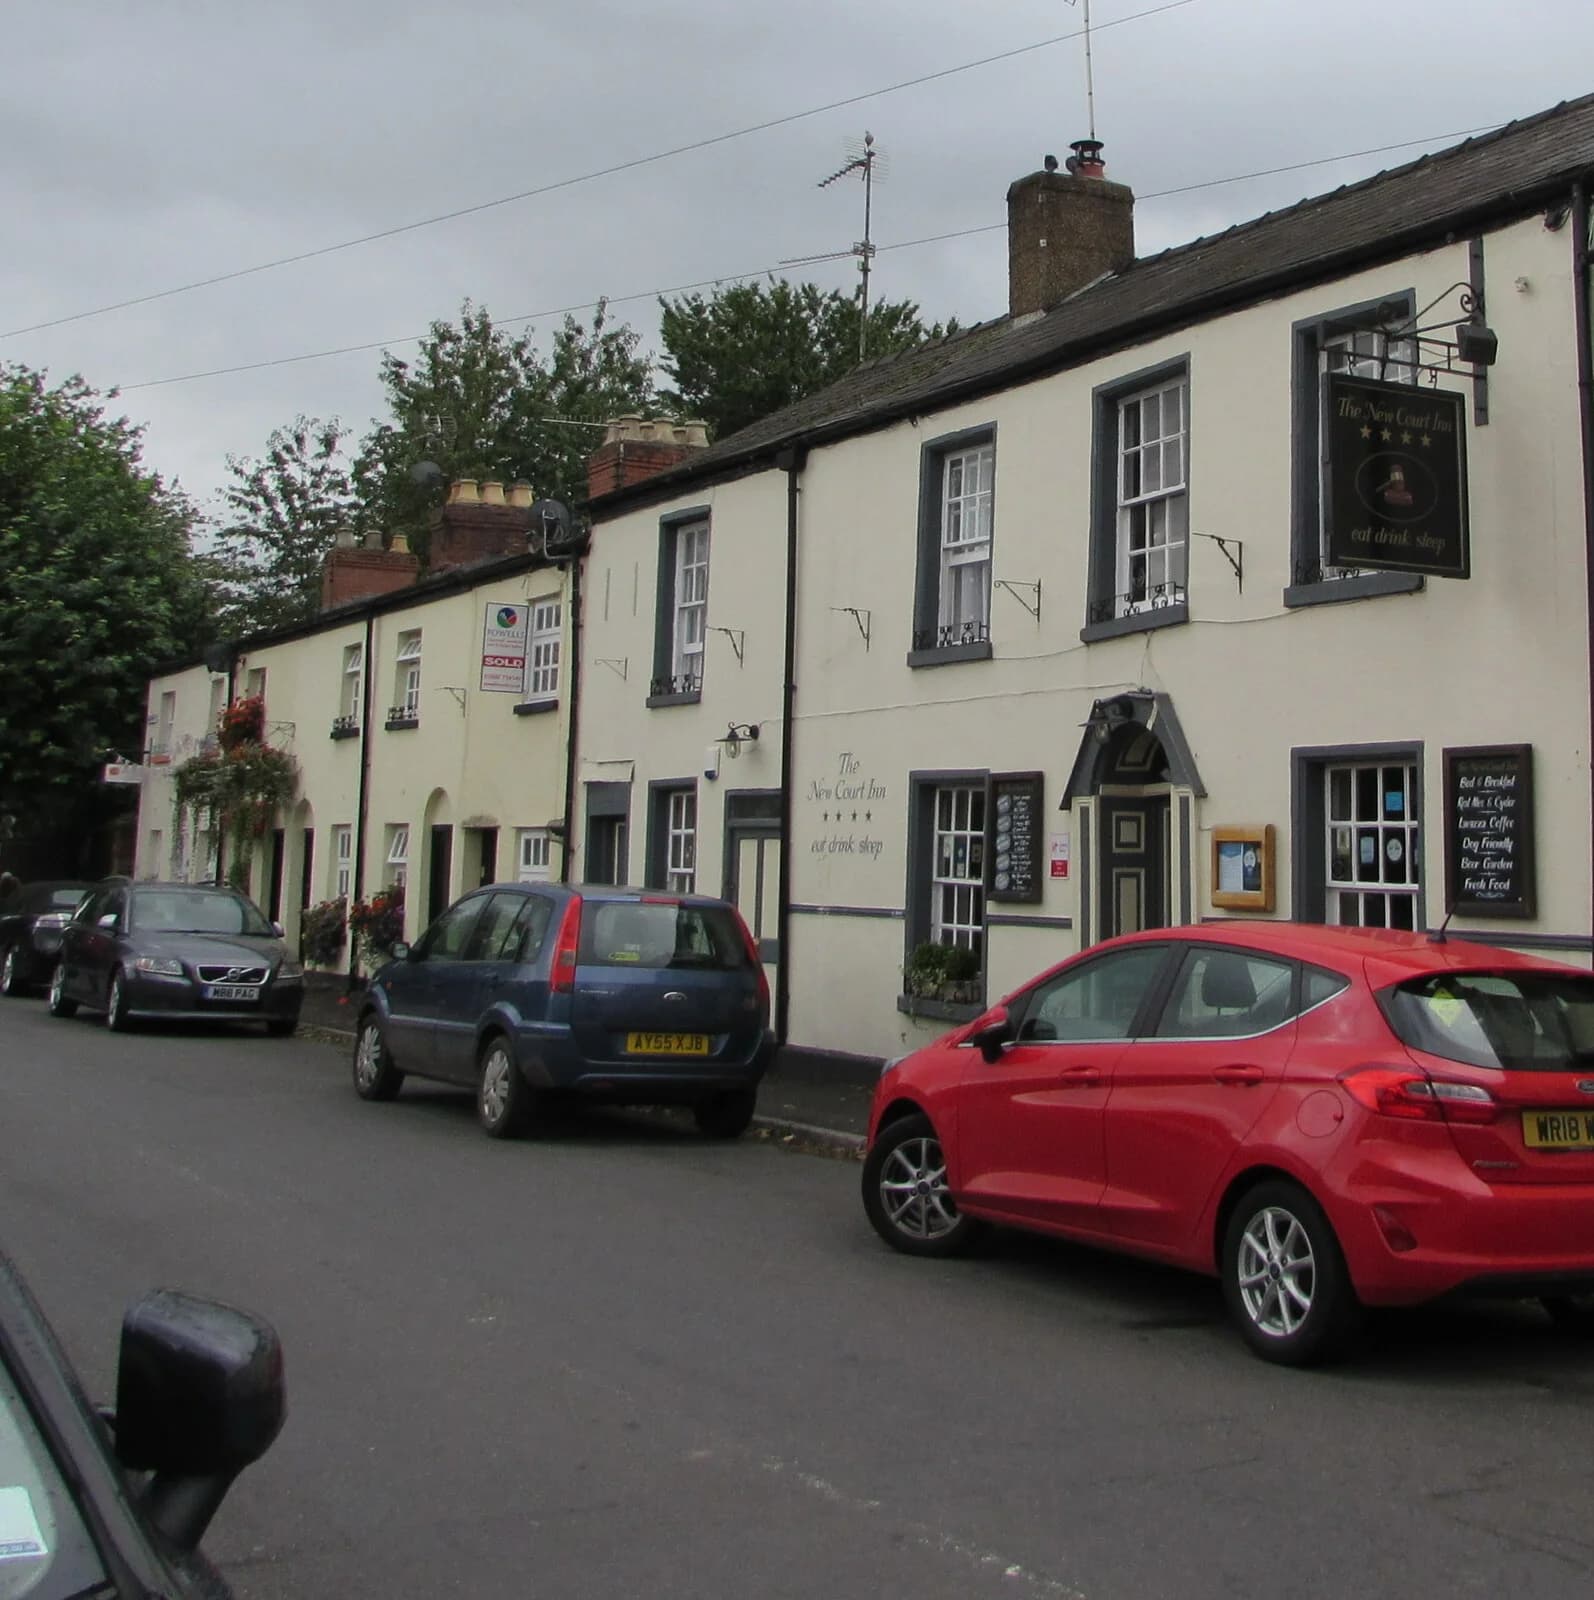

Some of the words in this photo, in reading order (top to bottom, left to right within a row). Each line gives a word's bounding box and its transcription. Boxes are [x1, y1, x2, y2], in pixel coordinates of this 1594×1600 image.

[1338, 397, 1361, 417] The
[1364, 402, 1393, 423] New
[1396, 408, 1431, 428] Court
[1432, 411, 1452, 433] Inn
[1351, 527, 1372, 543] eat
[1375, 527, 1410, 545] drink
[1416, 531, 1447, 557] sleep
[484, 657, 523, 668] SOLD
[839, 752, 860, 775] The
[807, 778, 833, 801] New
[835, 779, 865, 800] Court
[867, 778, 886, 800] Inn
[1459, 776, 1475, 789] Bed
[1494, 795, 1516, 812] Cyder
[1489, 815, 1515, 833] Coffee
[811, 837, 828, 853] eat
[829, 835, 854, 853] drink
[859, 834, 883, 861] sleep
[1462, 837, 1480, 854] Dog
[1481, 836, 1514, 854] Friendly
[1461, 857, 1480, 870] Beer
[1483, 857, 1513, 870] Garden
[1464, 878, 1486, 891] Fresh
[1488, 878, 1511, 890] Food
[634, 1034, 672, 1050] AY55
[676, 1035, 703, 1050] XJB
[1536, 1116, 1580, 1142] WR18
